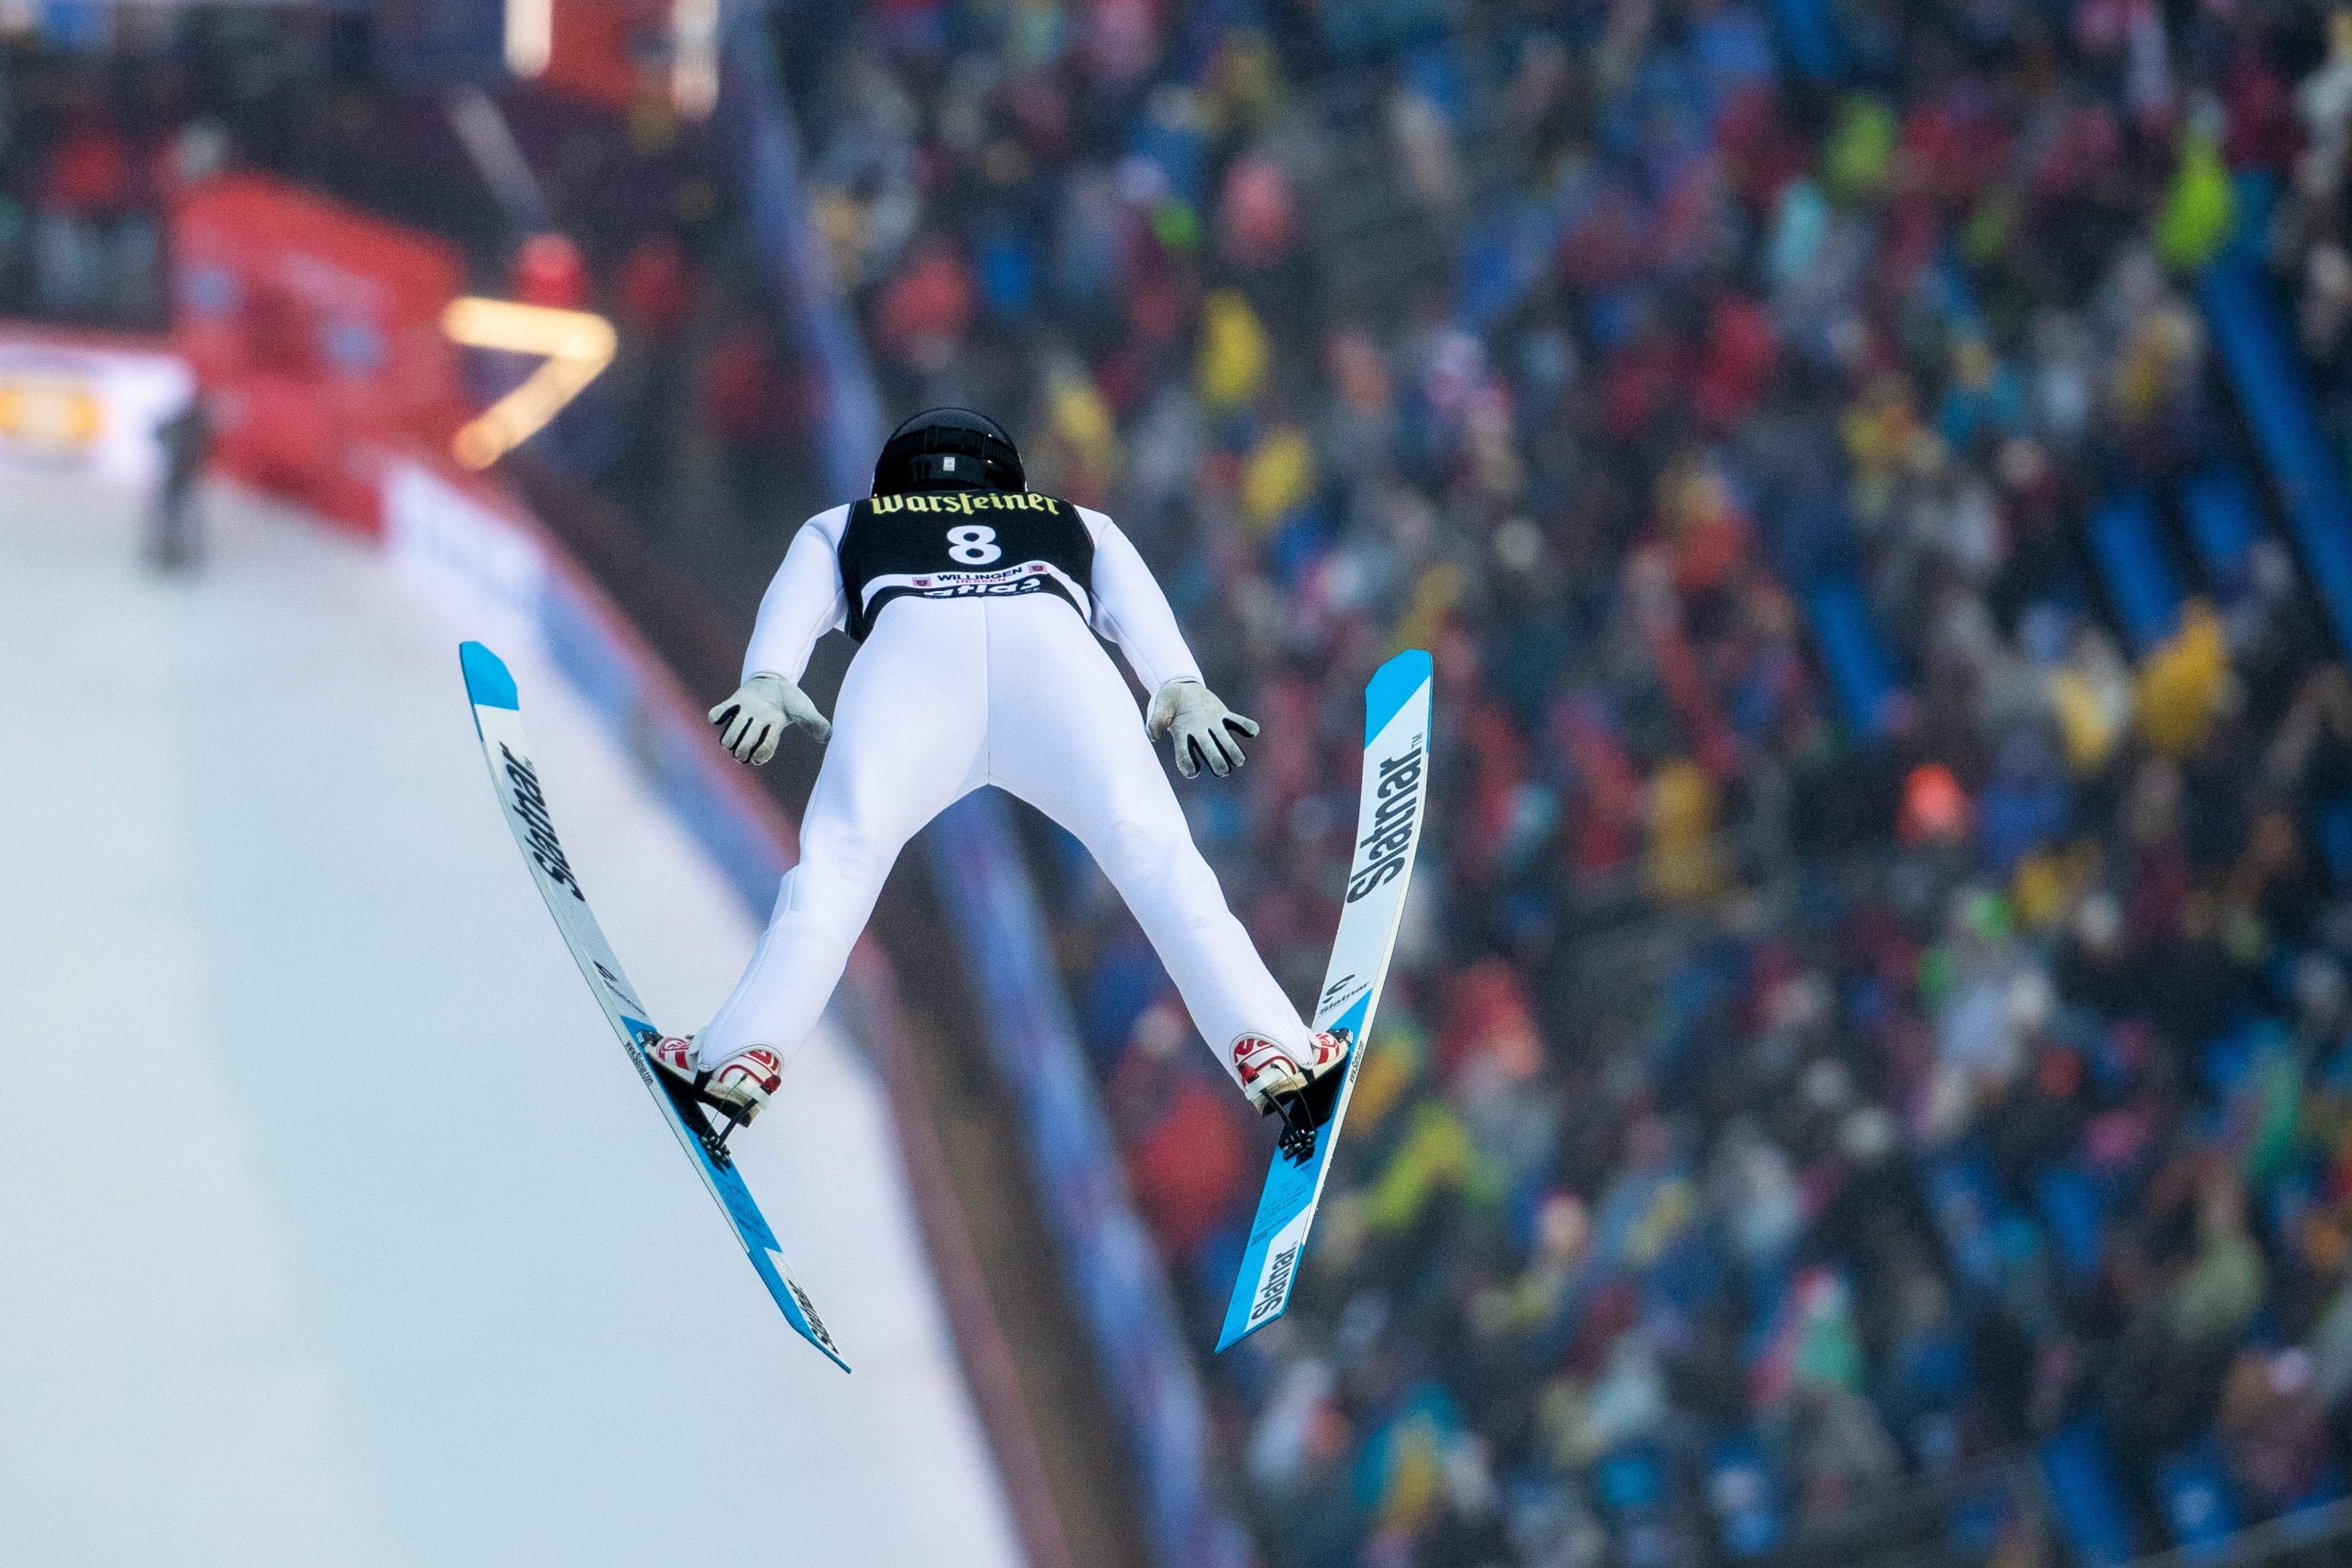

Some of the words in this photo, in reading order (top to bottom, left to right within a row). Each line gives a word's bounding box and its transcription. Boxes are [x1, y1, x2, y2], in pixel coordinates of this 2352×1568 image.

[869, 493, 1059, 515] Warsteiner
[947, 525, 1001, 565] 8
[937, 567, 1023, 581] WILLINGEN
[499, 740, 586, 902] Slatnar
[1347, 746, 1422, 904] Slatnar
[1319, 981, 1370, 1015] Slatnar
[1251, 1246, 1295, 1320] Slatnar
